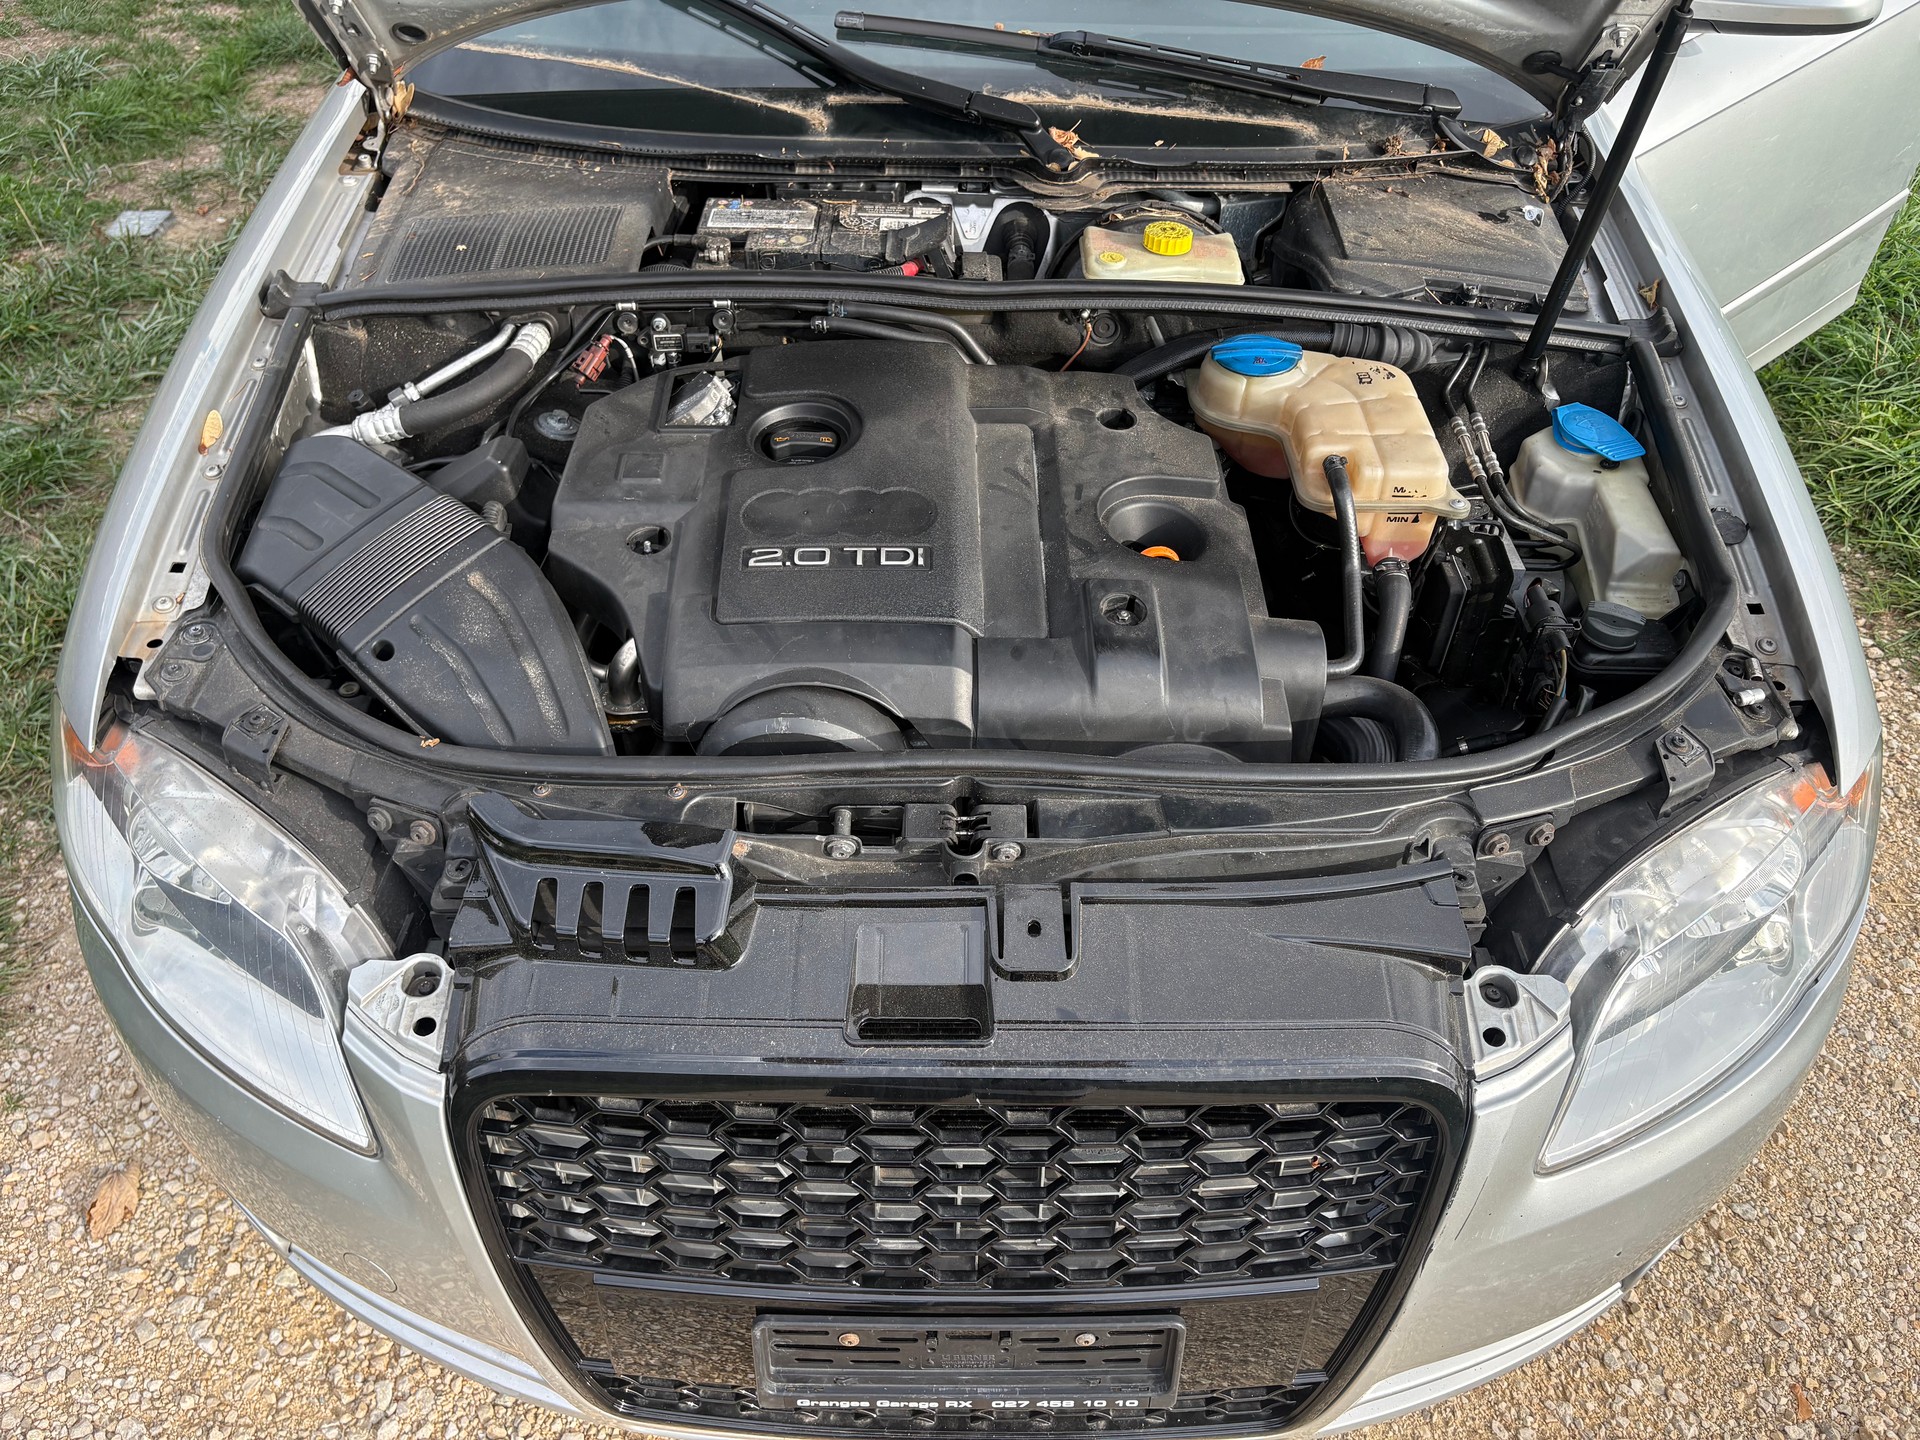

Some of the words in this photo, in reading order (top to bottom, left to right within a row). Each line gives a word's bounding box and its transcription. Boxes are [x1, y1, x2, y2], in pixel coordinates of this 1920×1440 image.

[748, 547, 830, 567] 2.0
[796, 1399, 870, 1408] Granges
[876, 1399, 939, 1409] Garage
[945, 1400, 973, 1408] RX
[991, 1400, 1030, 1408] 027
[1036, 1400, 1075, 1408] 458
[1082, 1400, 1107, 1408] 10
[1115, 1399, 1139, 1407] 10
